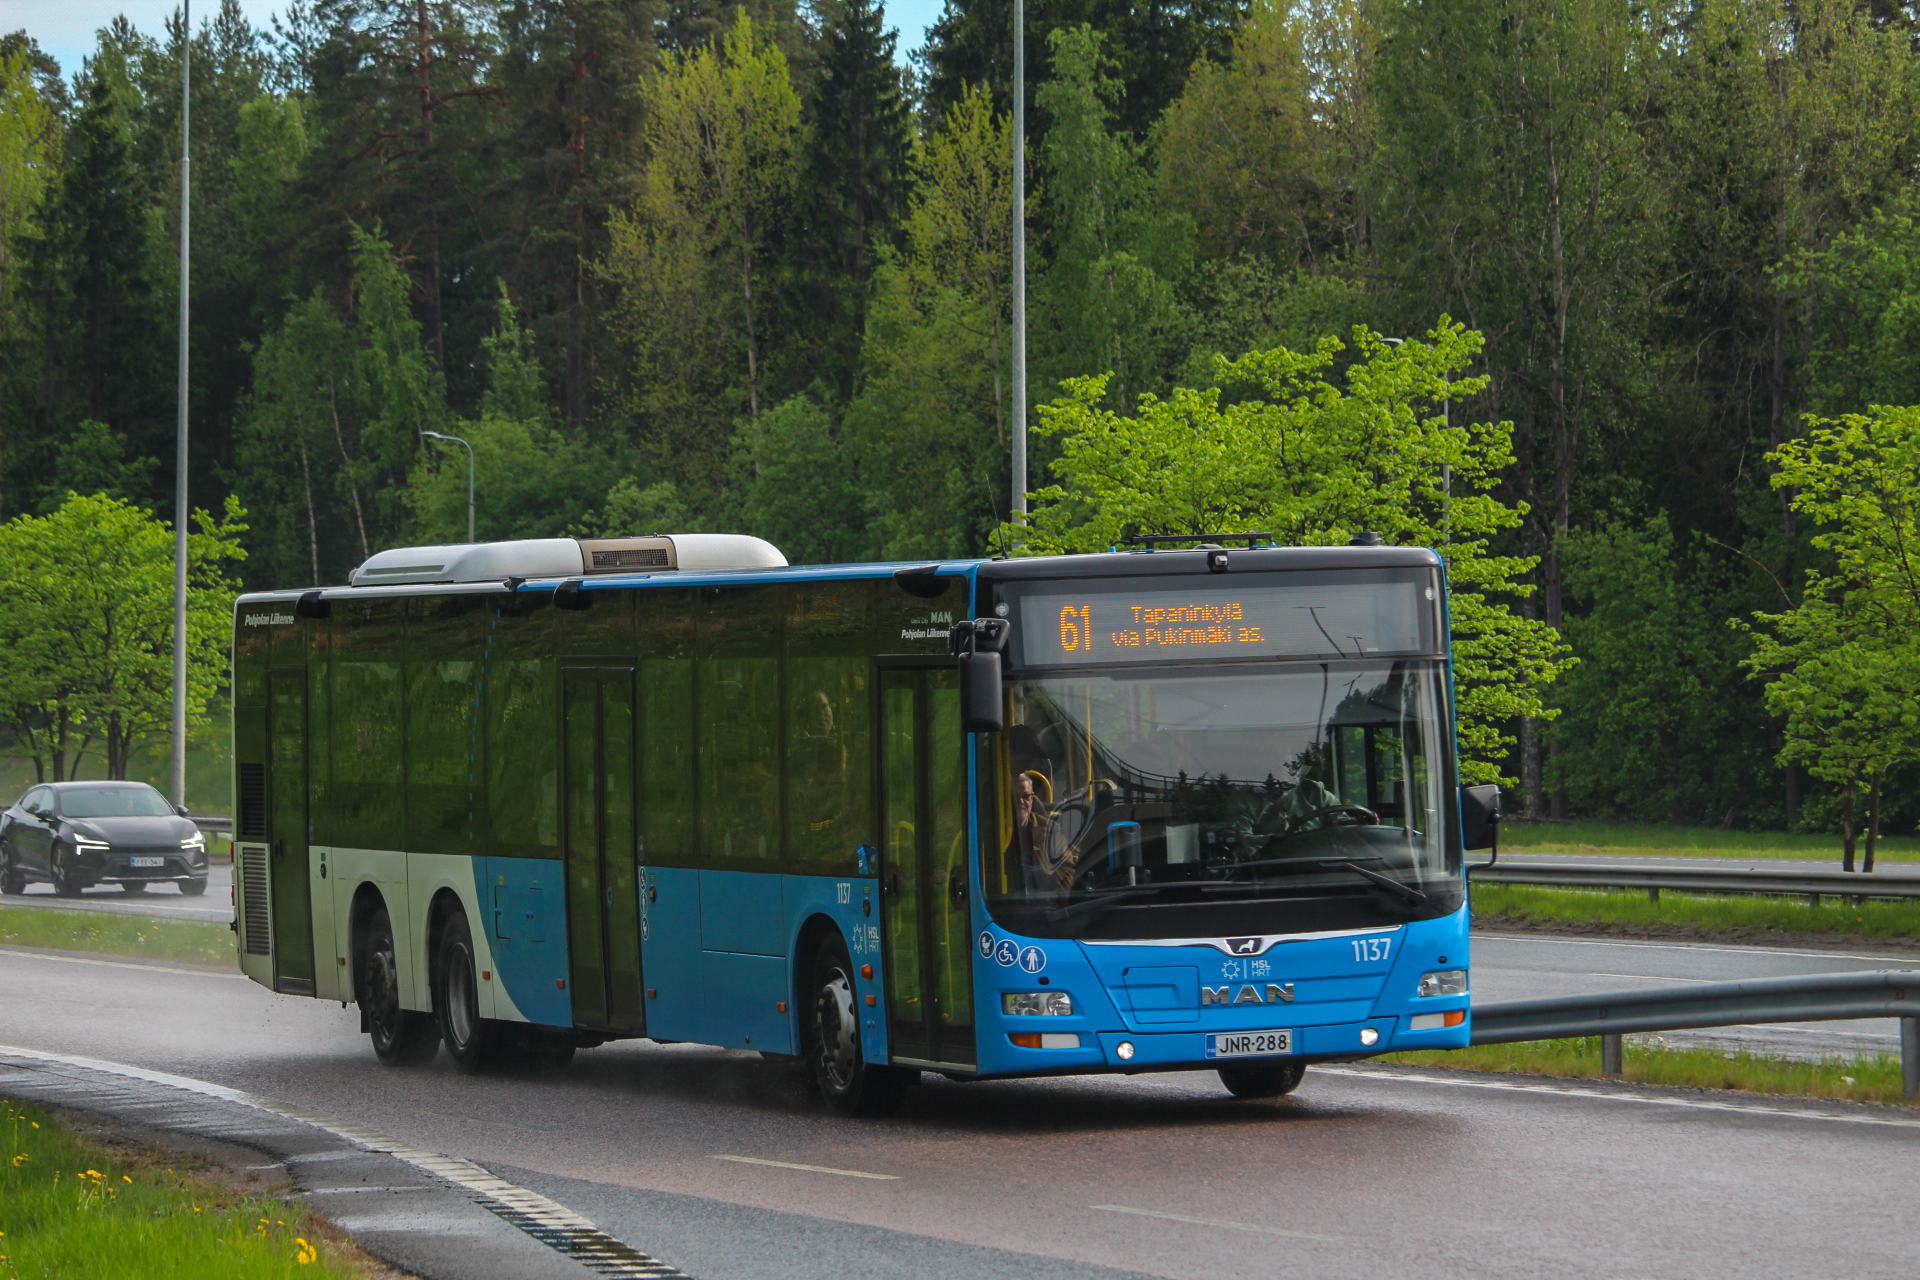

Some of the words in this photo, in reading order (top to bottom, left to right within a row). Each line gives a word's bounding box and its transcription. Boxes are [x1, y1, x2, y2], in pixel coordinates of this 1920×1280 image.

[245, 613, 269, 627] Pohjolan
[270, 613, 294, 624] Liikenne
[931, 611, 951, 623] MAN
[1131, 603, 1242, 625] Tapaninkylä
[902, 629, 925, 640] Pohjolan
[927, 628, 950, 638] Liikenne
[1060, 605, 1091, 651] 61
[1112, 629, 1140, 646] via
[1145, 626, 1232, 645] Pukinmäki
[1238, 627, 1265, 642] as.
[836, 883, 851, 904] 1137
[868, 927, 879, 939] HSL
[868, 940, 880, 952] HRT
[1351, 938, 1391, 962] 1137
[1251, 960, 1271, 969] HSL
[1251, 968, 1271, 977] HRT
[1201, 983, 1295, 1006] MAN
[1219, 1034, 1287, 1054] JNR-288
